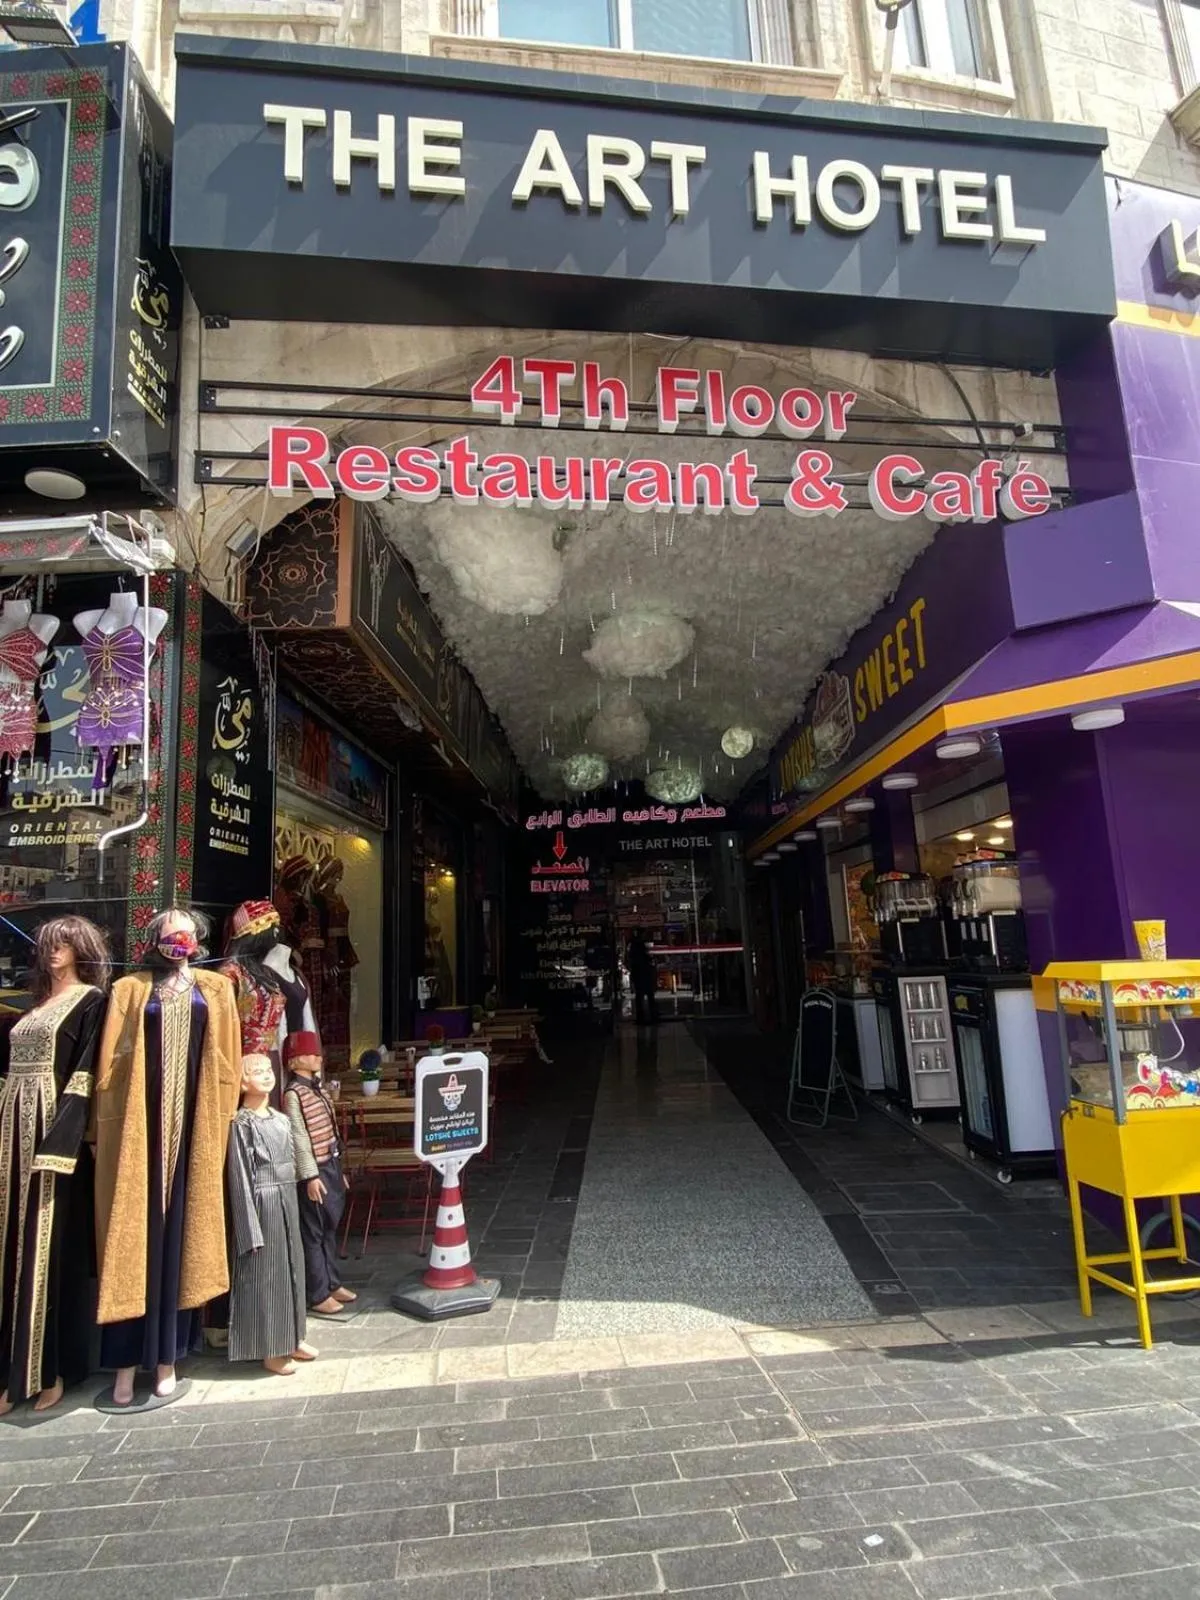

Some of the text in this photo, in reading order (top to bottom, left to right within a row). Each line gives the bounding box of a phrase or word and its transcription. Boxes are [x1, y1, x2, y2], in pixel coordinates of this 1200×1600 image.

[264, 103, 1047, 243] THE ART HOTEL
[471, 355, 858, 441] 4Th Floor
[268, 425, 1054, 524] Restaurant & Café
[854, 597, 926, 723] SWEET
[12, 786, 105, 813] الشرقية
[211, 772, 250, 801] للمطرزات
[210, 797, 250, 825] الشرقية
[526, 802, 726, 829] مطعم وكافيه الطابق الرابع
[8, 832, 102, 847] EMBROIDERIES
[10, 820, 103, 833] ORIENTAL
[210, 826, 249, 846] ORIENTAL
[619, 836, 712, 851] THE ART HOTEL
[530, 879, 590, 893] ELEVATOR
